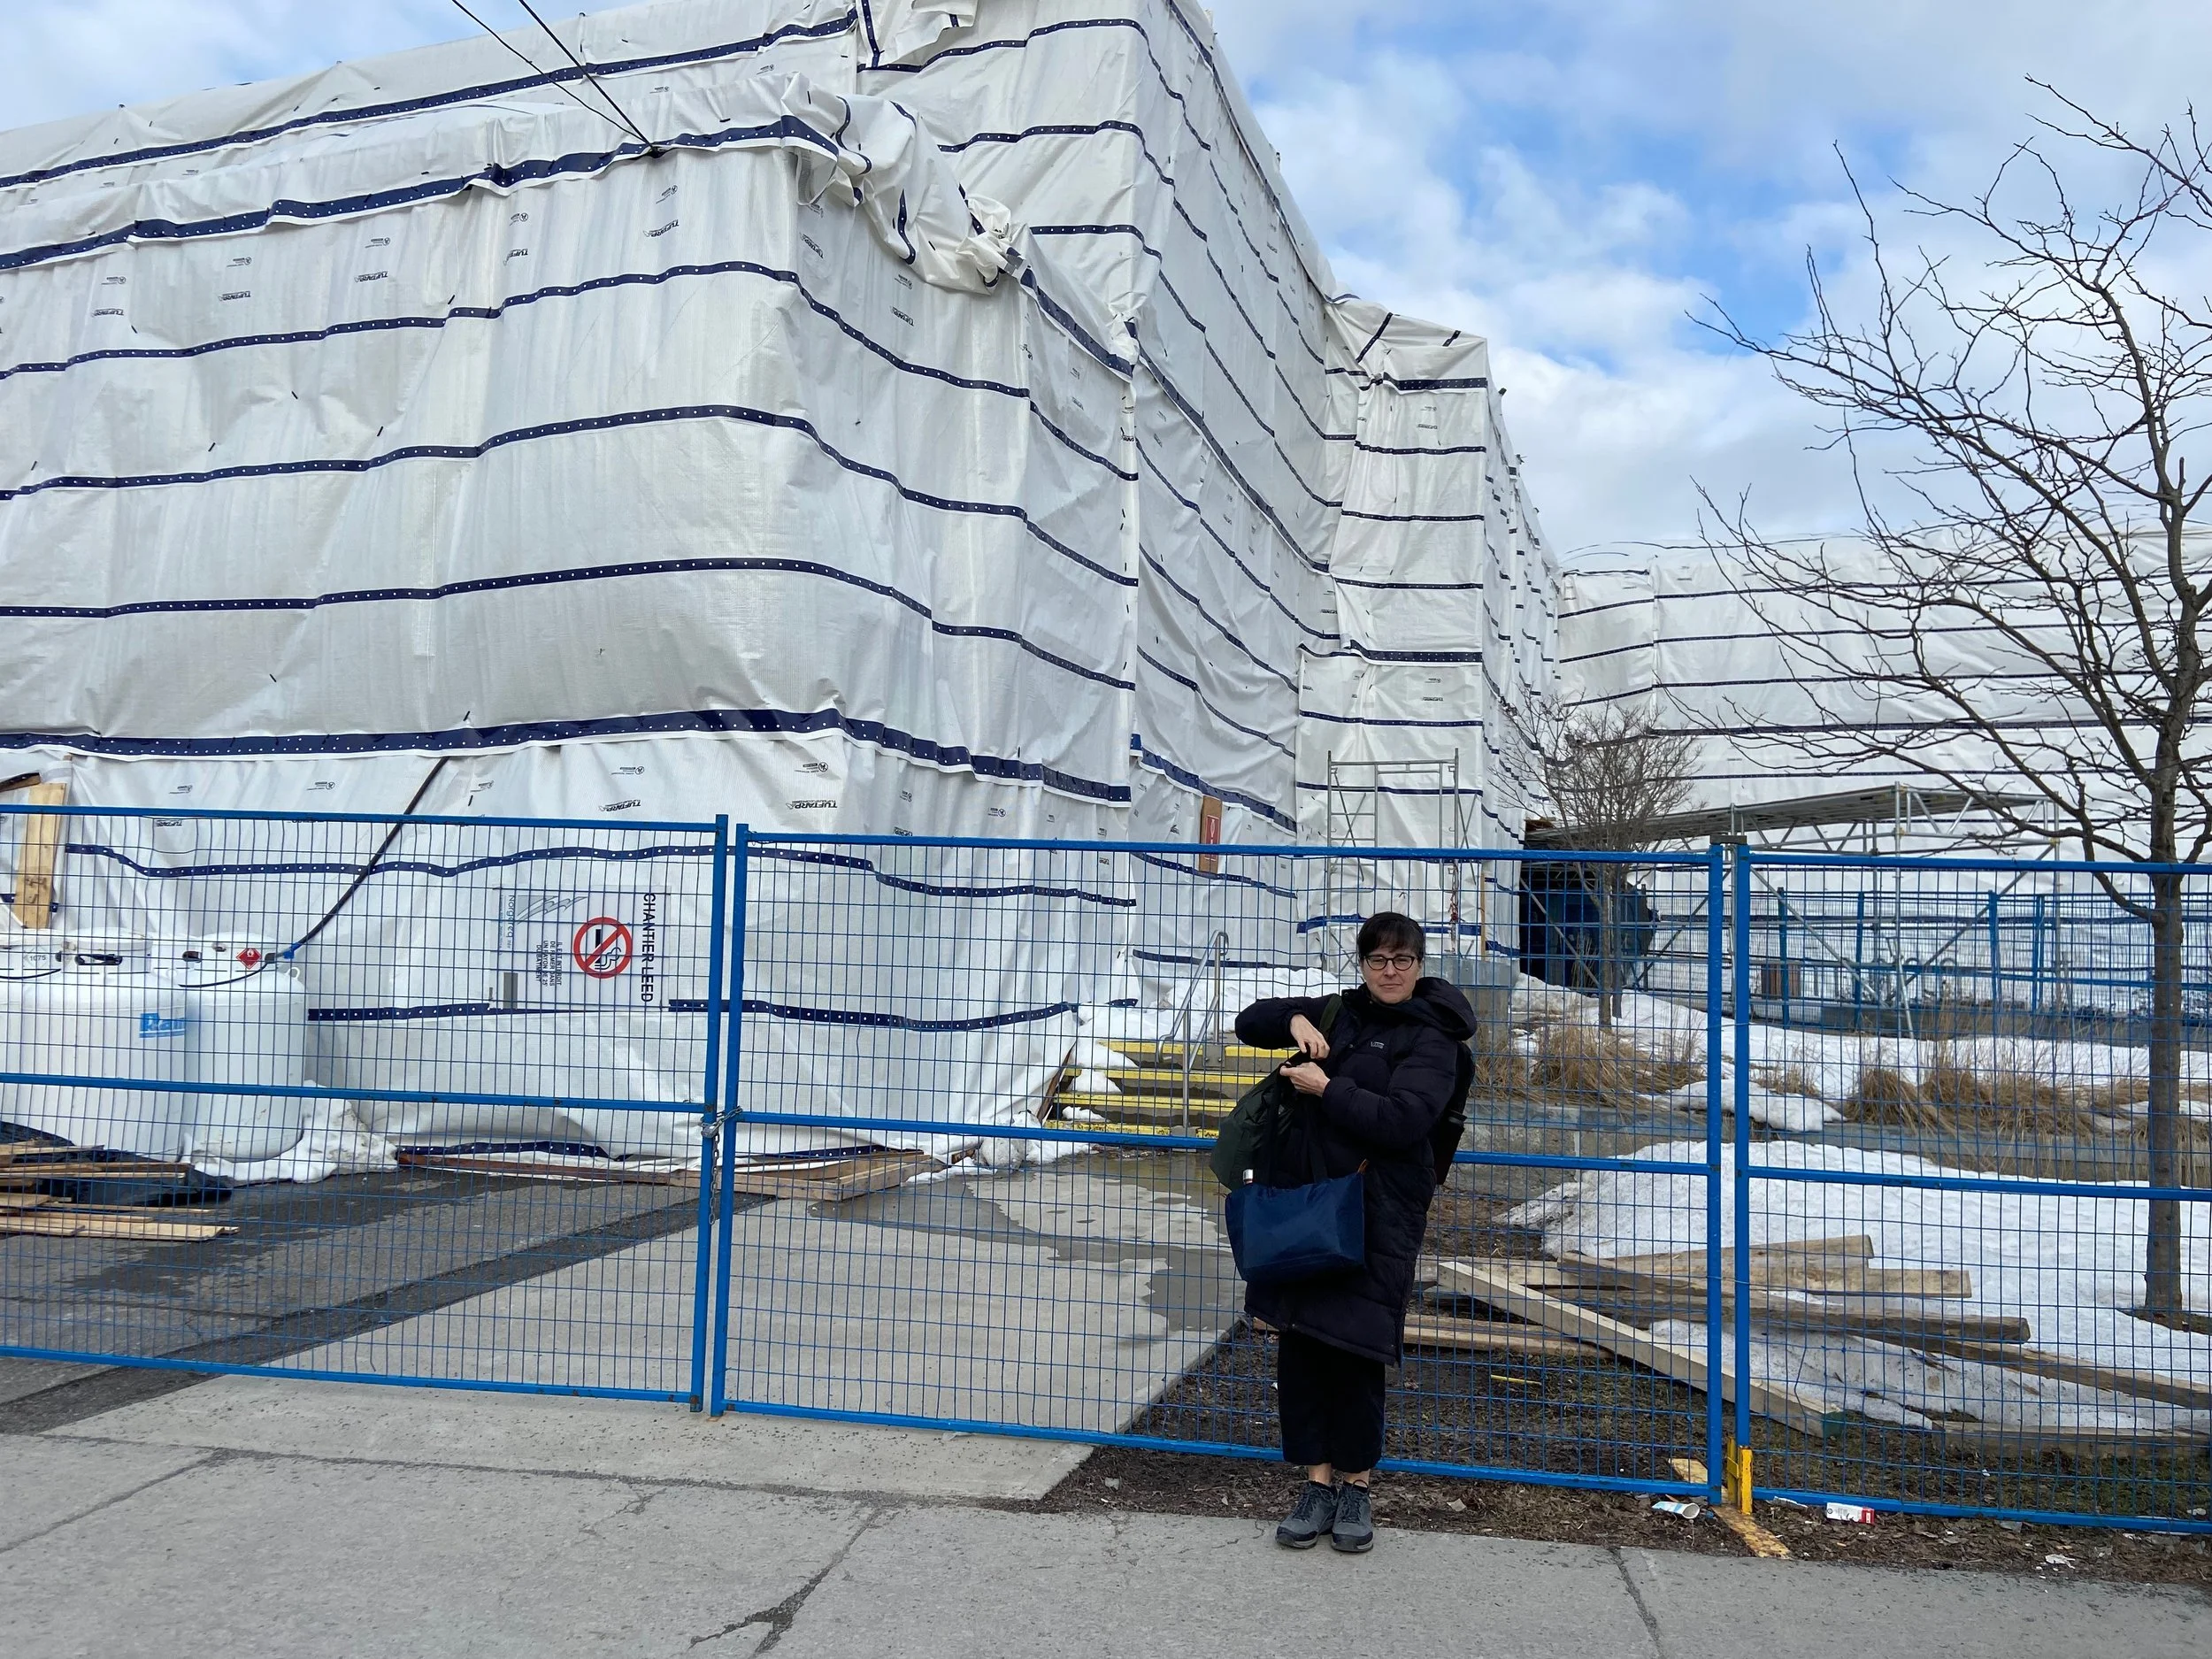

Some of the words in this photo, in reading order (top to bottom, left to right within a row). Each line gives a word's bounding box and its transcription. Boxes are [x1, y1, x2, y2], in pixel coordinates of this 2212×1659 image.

[606, 802, 641, 812] TUFTARP
[641, 893, 656, 963] CHANTIER
[543, 940, 549, 949] UN
[641, 966, 654, 1002] LEED
